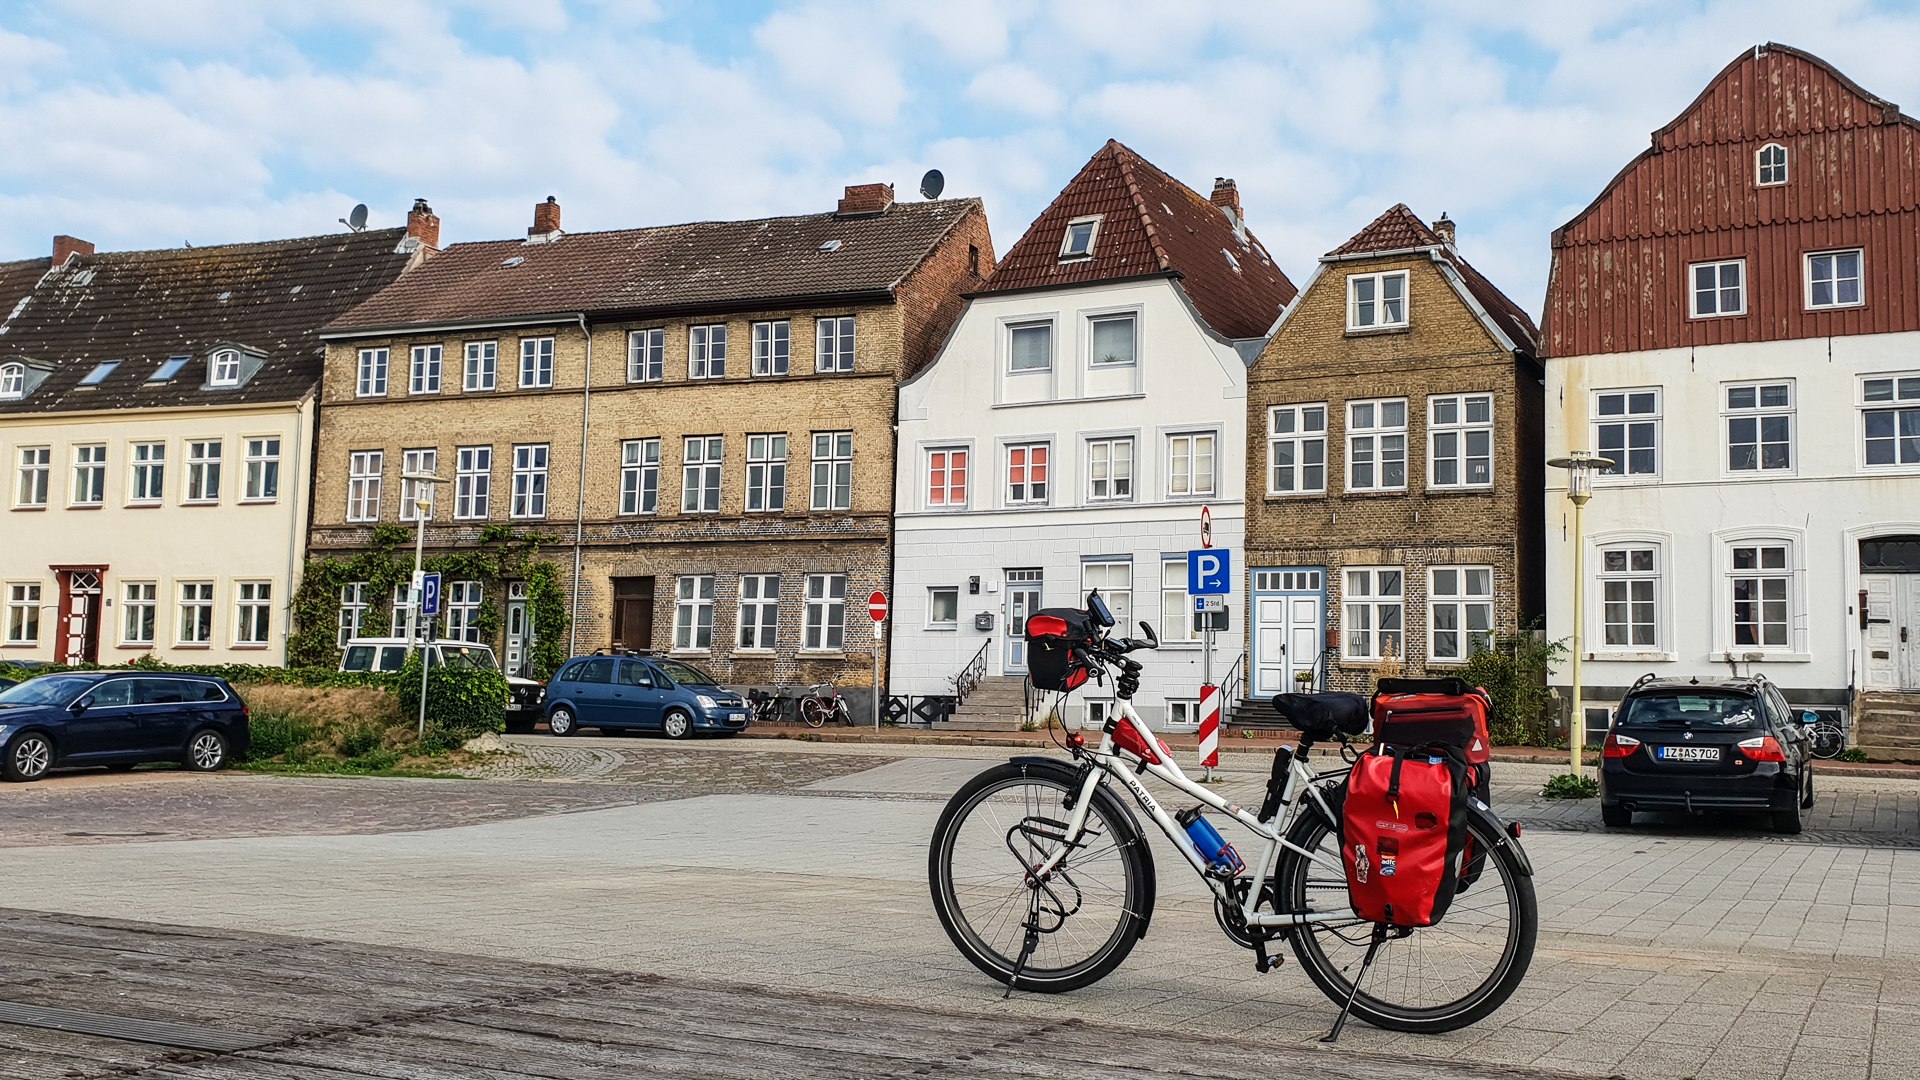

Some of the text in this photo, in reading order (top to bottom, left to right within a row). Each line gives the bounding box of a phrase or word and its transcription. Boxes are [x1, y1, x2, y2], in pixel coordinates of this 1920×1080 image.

[1197, 555, 1220, 589] P
[425, 580, 435, 610] P
[1665, 747, 1718, 759] IZ AS 702
[1129, 780, 1156, 812] PATRIA
